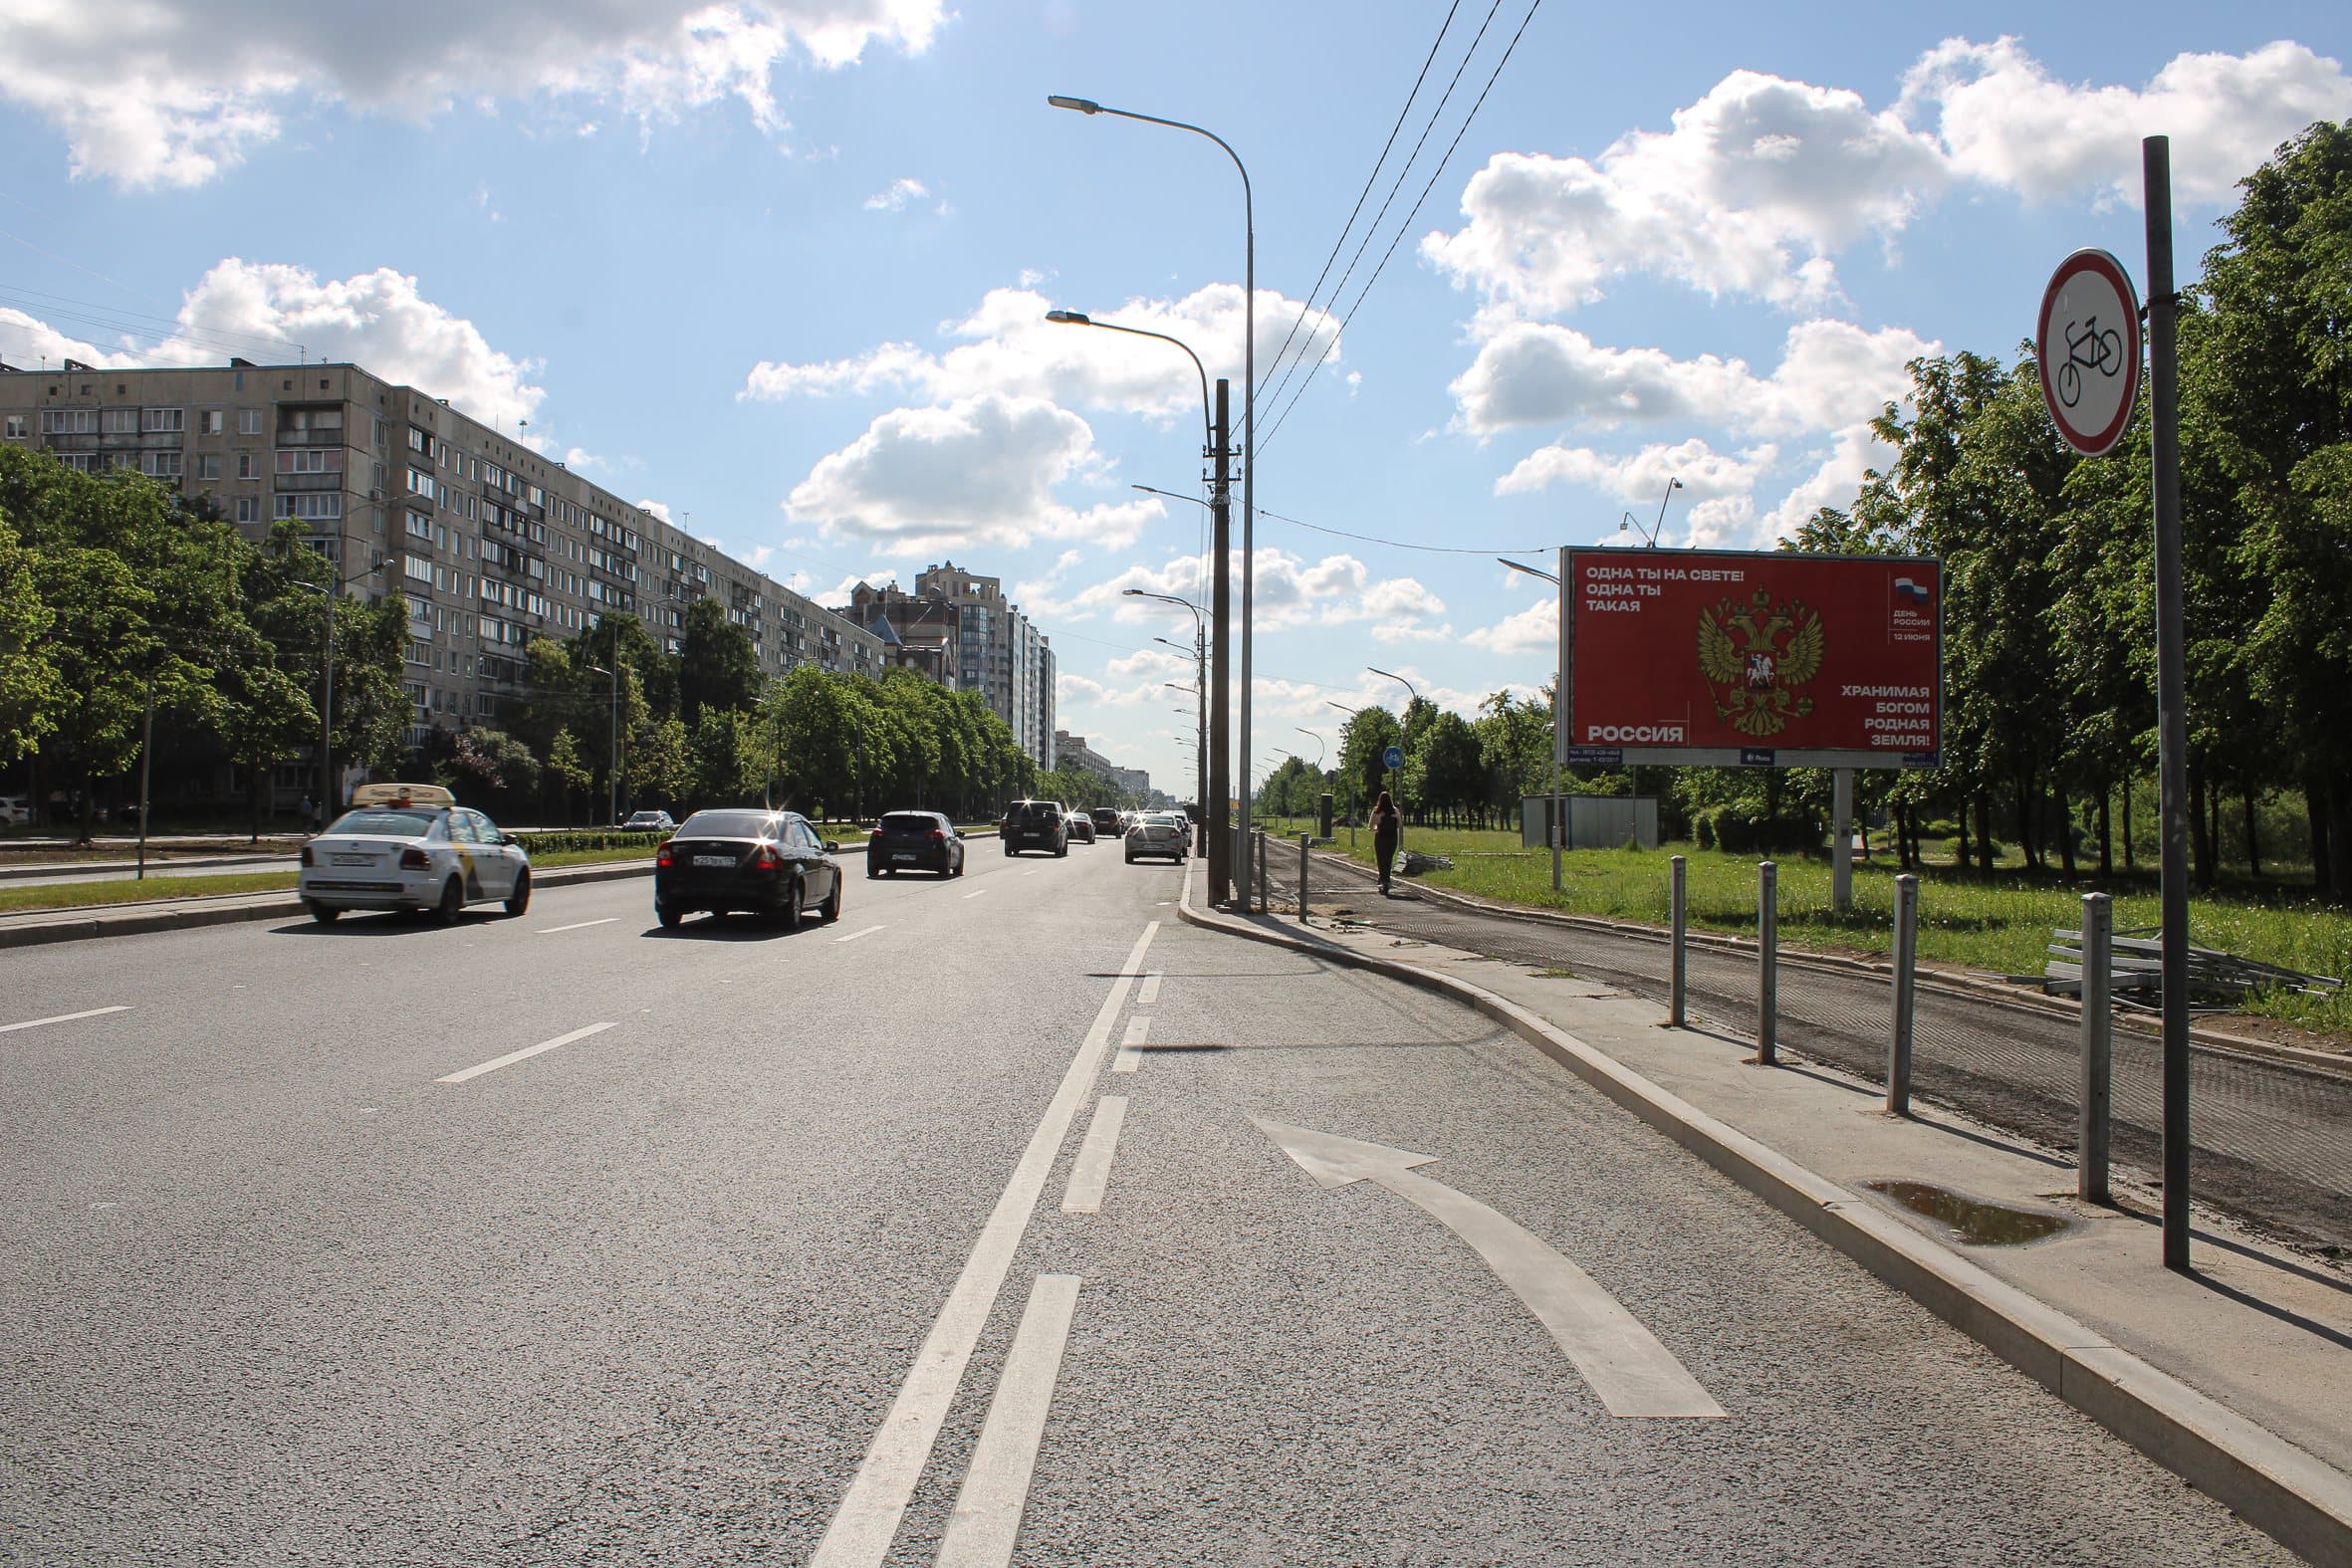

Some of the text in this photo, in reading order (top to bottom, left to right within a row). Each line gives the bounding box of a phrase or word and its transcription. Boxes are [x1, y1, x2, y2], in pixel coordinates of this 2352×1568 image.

[1586, 566, 1745, 581] ОДНА ТЫ НА СВЕТЕ!
[1586, 583, 1661, 596] ОДНА ТЫ
[1586, 599, 1641, 612] ТАКАЯ
[1840, 685, 1930, 698] ХРАНИМАЯ
[1876, 702, 1930, 714] БОГОМ
[1864, 718, 1930, 732] РОДНАЯ
[1587, 725, 1683, 743] РОССИЯ
[1871, 735, 1930, 747] ЗЕМЛЯ!
